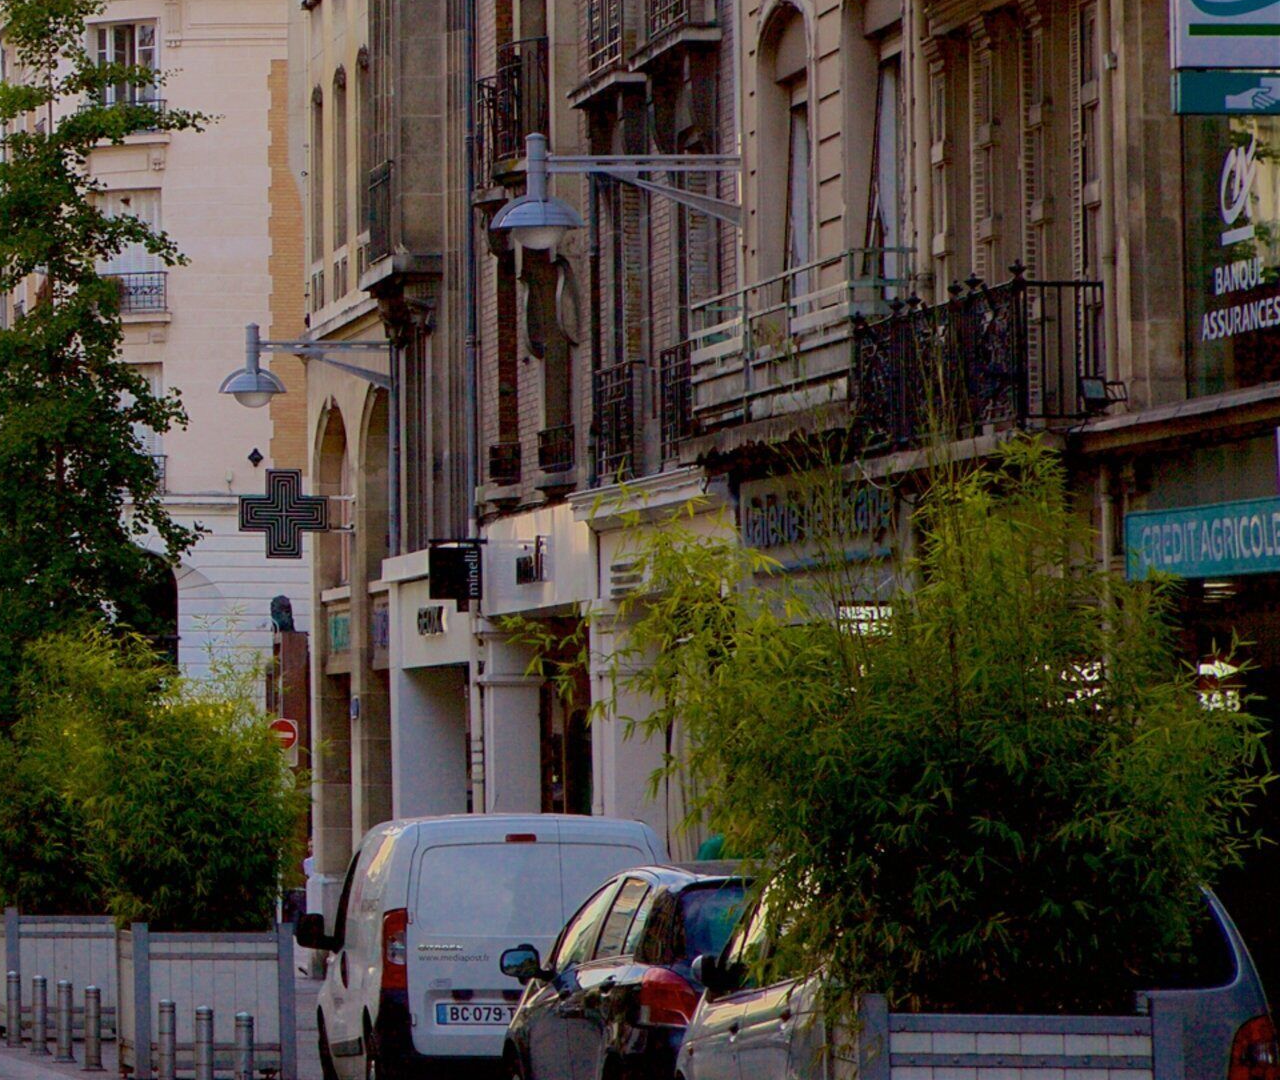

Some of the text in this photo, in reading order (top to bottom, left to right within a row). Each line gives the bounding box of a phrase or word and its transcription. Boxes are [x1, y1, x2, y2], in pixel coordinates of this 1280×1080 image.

[1215, 257, 1265, 295] BANQUE
[1202, 296, 1280, 341] ASSURANCES
[1201, 512, 1280, 562] AGRICOLE
[464, 551, 478, 596] minelli
